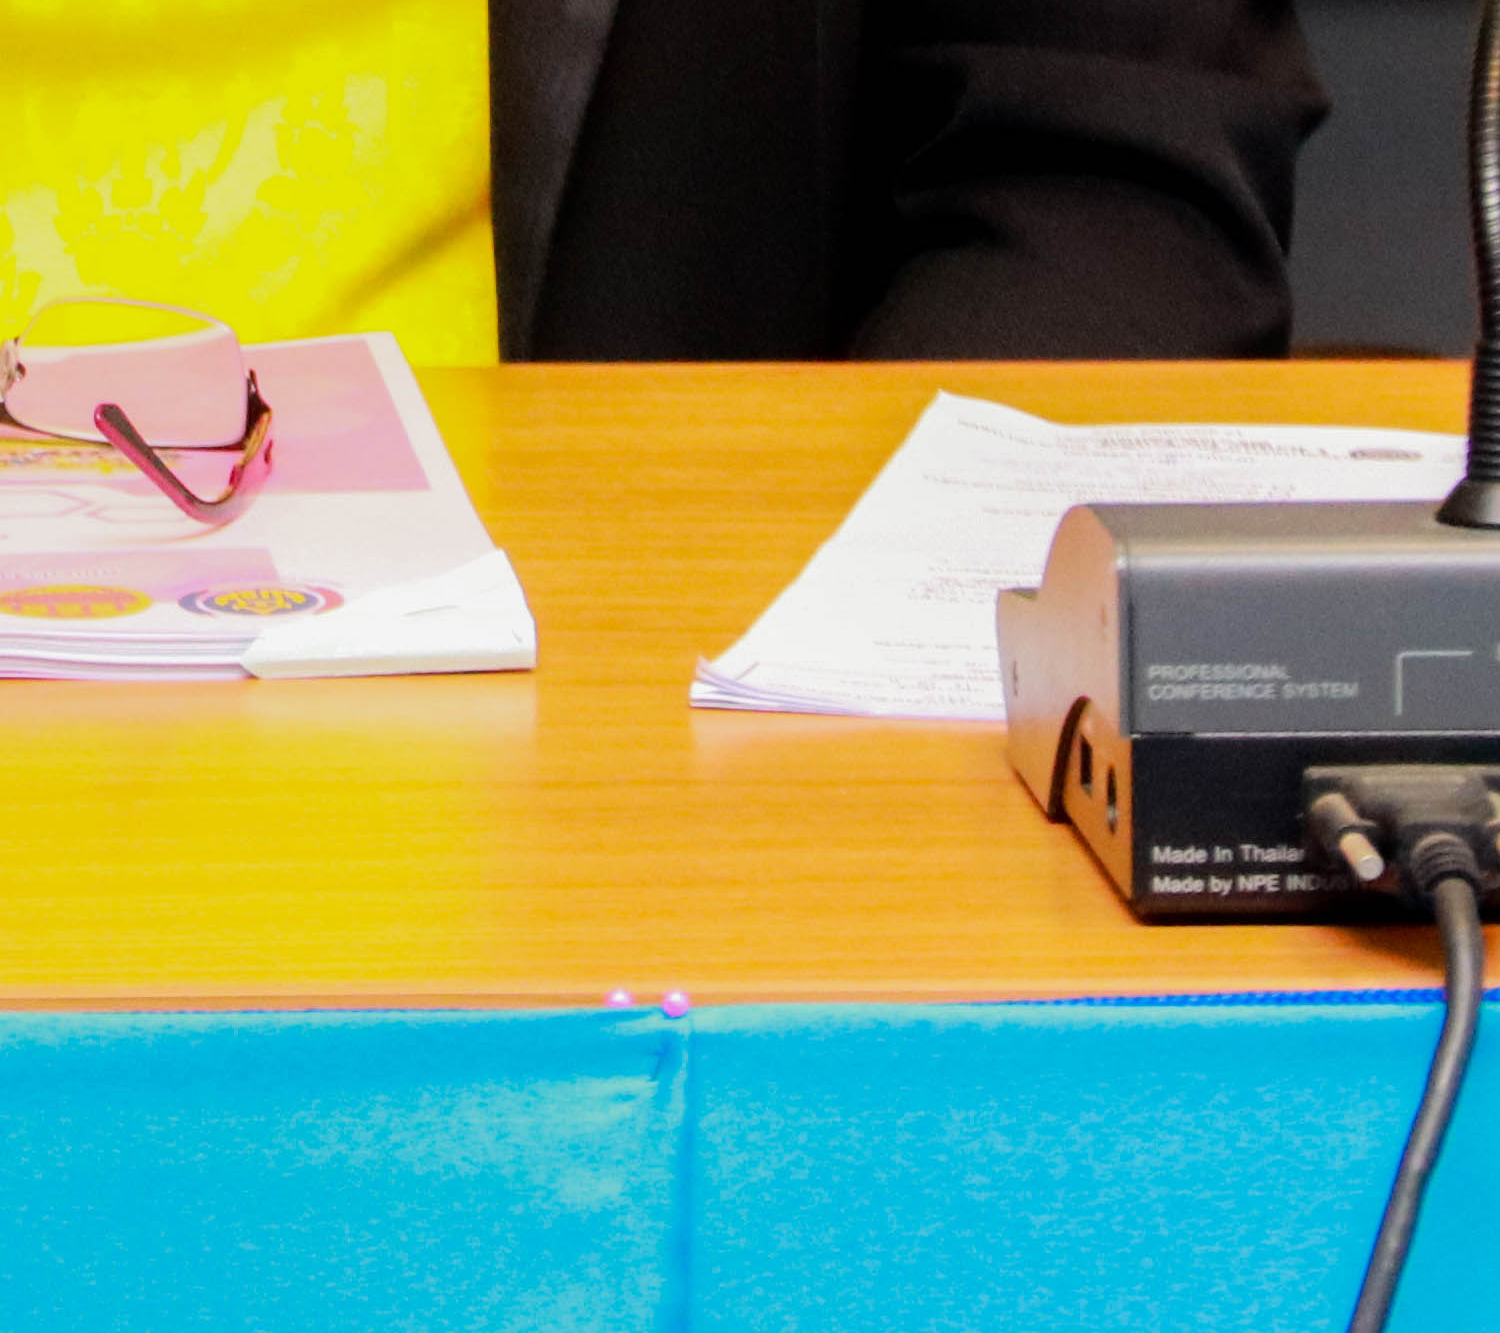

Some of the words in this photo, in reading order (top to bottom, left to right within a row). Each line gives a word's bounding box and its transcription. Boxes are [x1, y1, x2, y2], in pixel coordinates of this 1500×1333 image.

[1148, 664, 1291, 681] PROFESSIONAL
[1148, 683, 1277, 700] CONFERENCE
[1282, 682, 1359, 699] SYSTEM
[1152, 844, 1207, 864] Made
[1152, 875, 1205, 893] Made
[1208, 875, 1233, 897] by
[1237, 874, 1280, 892] NPE
